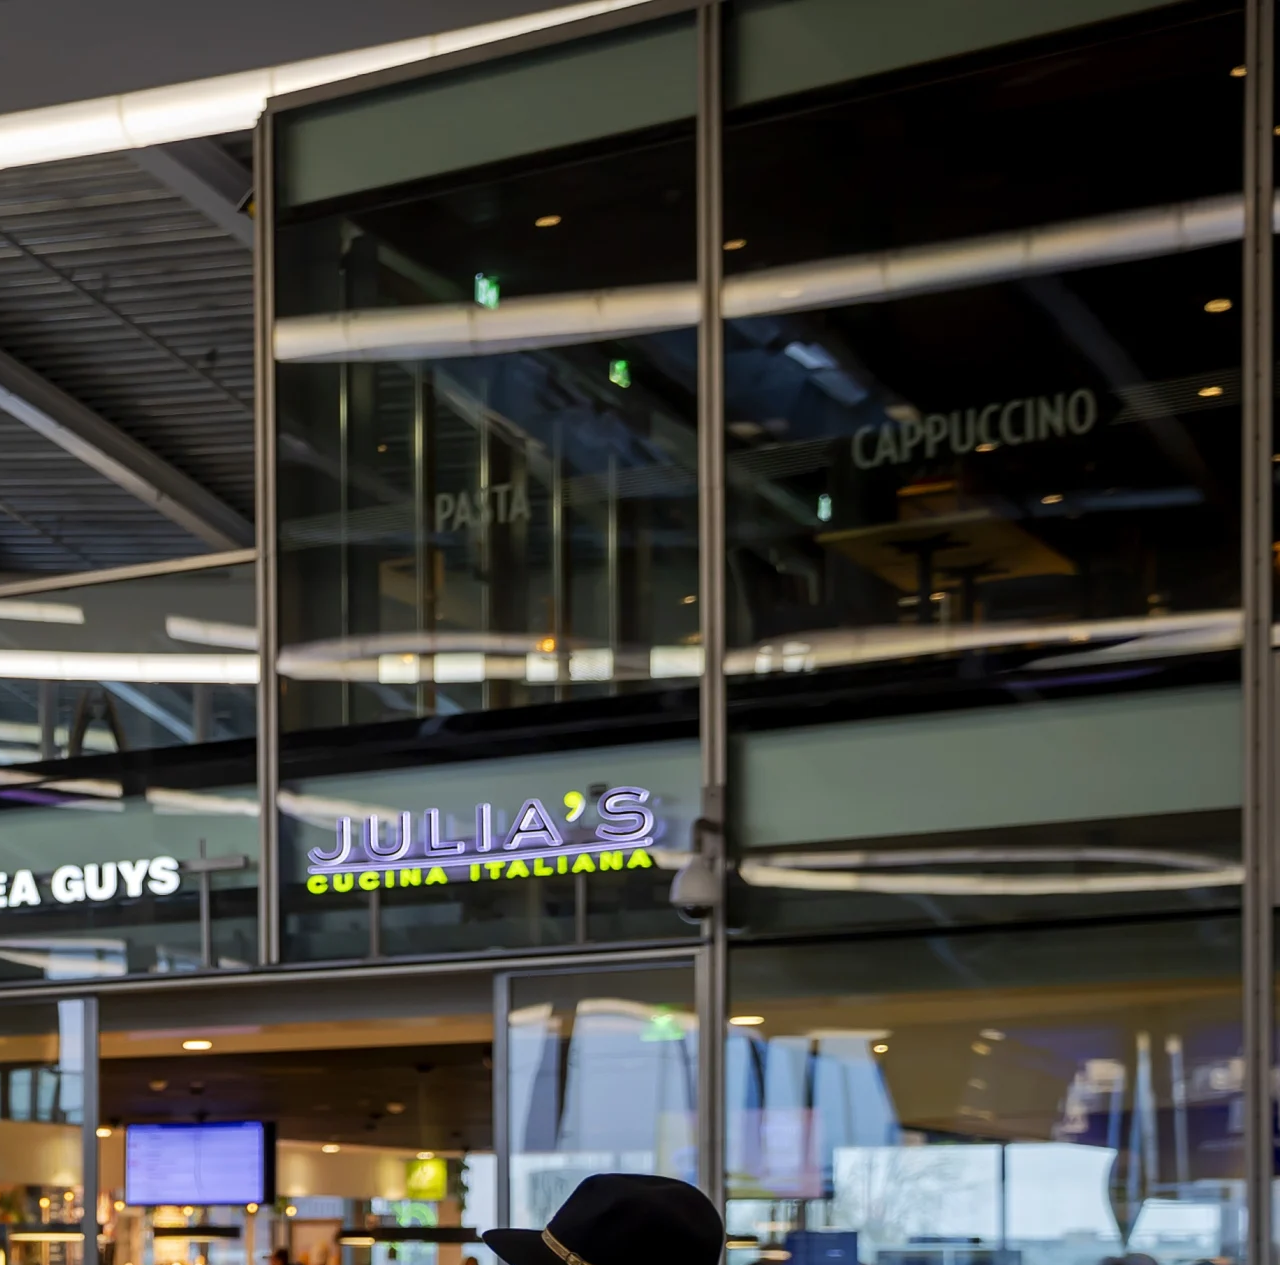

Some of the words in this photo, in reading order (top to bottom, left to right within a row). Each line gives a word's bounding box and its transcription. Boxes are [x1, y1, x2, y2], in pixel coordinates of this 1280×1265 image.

[851, 388, 1099, 470] CAPPUCCINO
[434, 483, 532, 534] PASTA
[51, 856, 171, 904] GUYS
[306, 866, 448, 895] CUCINA
[469, 848, 653, 882] ITALIANA
